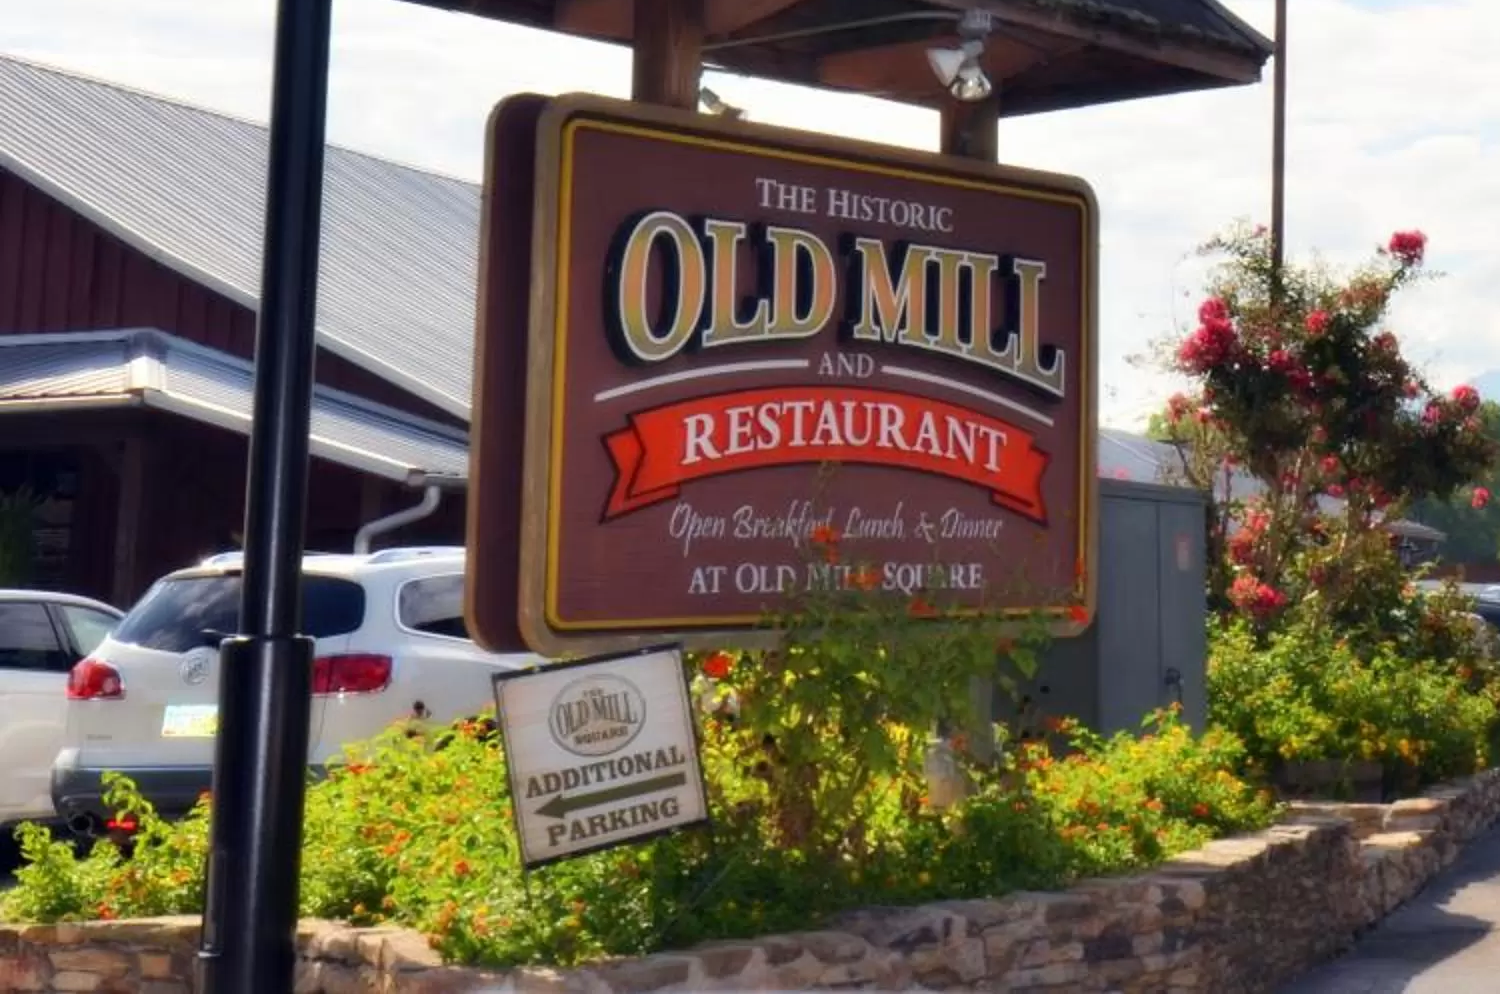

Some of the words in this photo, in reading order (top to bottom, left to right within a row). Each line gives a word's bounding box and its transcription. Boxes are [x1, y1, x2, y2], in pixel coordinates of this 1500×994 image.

[756, 178, 816, 214] THE
[827, 188, 953, 233] HISTORIC
[612, 210, 837, 363] OLD
[849, 237, 1065, 397] MILL
[817, 353, 875, 379] AND
[680, 399, 1008, 474] RESTAURANT
[669, 502, 726, 557] Open
[914, 511, 935, 543] &
[940, 507, 1003, 539] Dinner
[688, 566, 727, 594] AT
[735, 563, 797, 594] OLD
[556, 699, 590, 739] OLD
[590, 690, 638, 724] MILL
[526, 745, 685, 798] ADDITIONAL
[547, 797, 679, 846] PARKING
